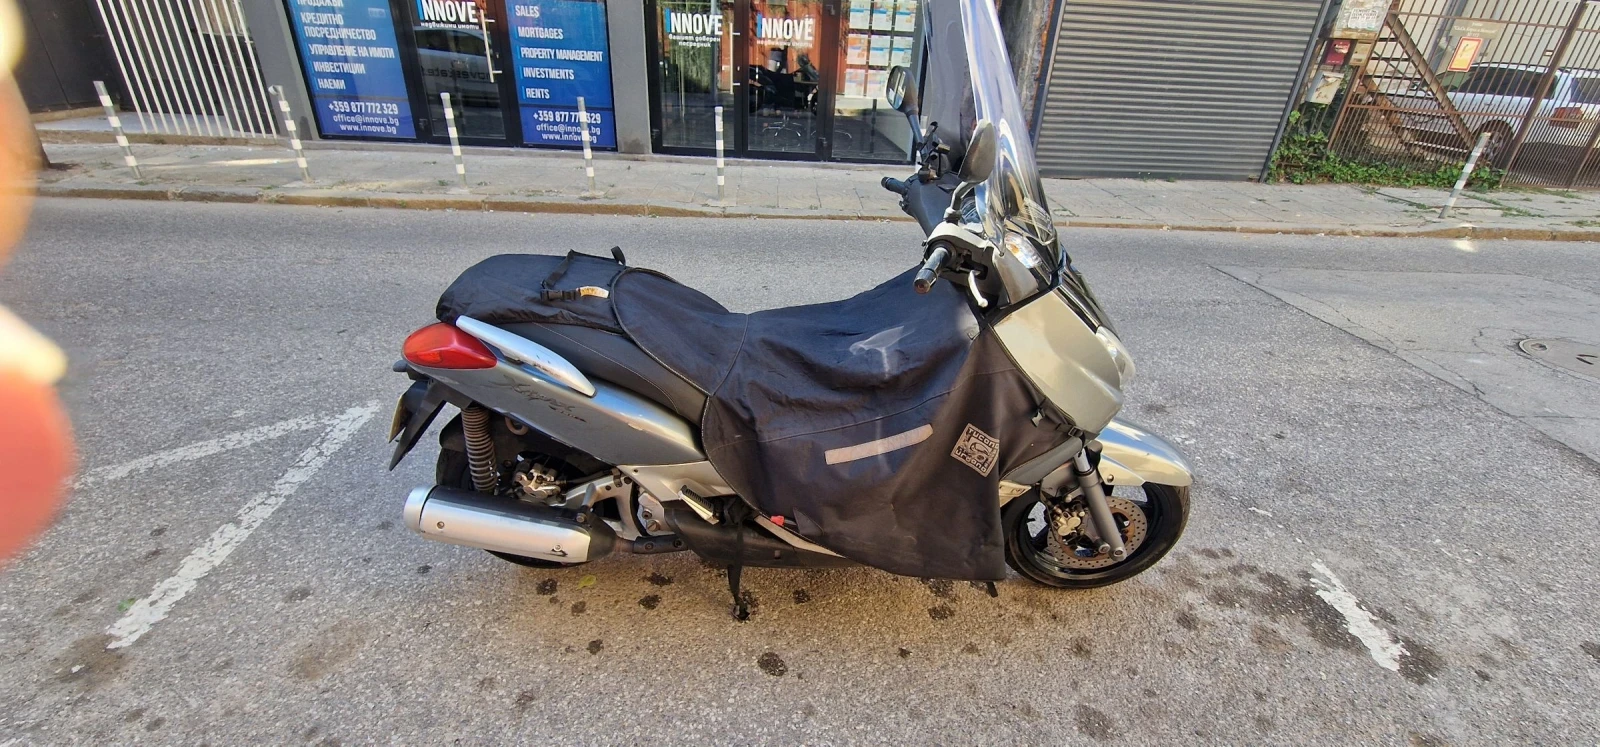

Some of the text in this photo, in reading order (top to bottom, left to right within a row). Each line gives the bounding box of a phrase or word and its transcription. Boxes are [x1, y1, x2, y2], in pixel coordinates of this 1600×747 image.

[415, 0, 478, 22] INNOVE
[515, 5, 540, 17] SALES
[300, 12, 343, 25] КРЕДИТНО
[665, 8, 723, 35] INNOVE
[517, 26, 564, 39] MORTGAGES
[756, 12, 813, 40] INNOVE
[304, 26, 376, 40] ПОСРЕДНИЧЕСТВО
[308, 44, 395, 58] УПРАВЛЕНИЕ НА ИМОТИ
[521, 47, 603, 62] PROPERTY MANAGEMENT
[313, 61, 366, 74] ИНВЕСТИЦИИ
[523, 67, 574, 80] INVESTMENTS
[317, 78, 346, 90] НАЕМИ
[526, 87, 550, 99] RENTS
[328, 101, 398, 115] +359 877 772 329
[333, 114, 399, 126] office@innove.bg
[533, 110, 601, 124] +359 877 77 329
[340, 124, 396, 134] www.innove.bg
[536, 123, 600, 135] office@inno.bg
[542, 132, 597, 144] www.innovbg
